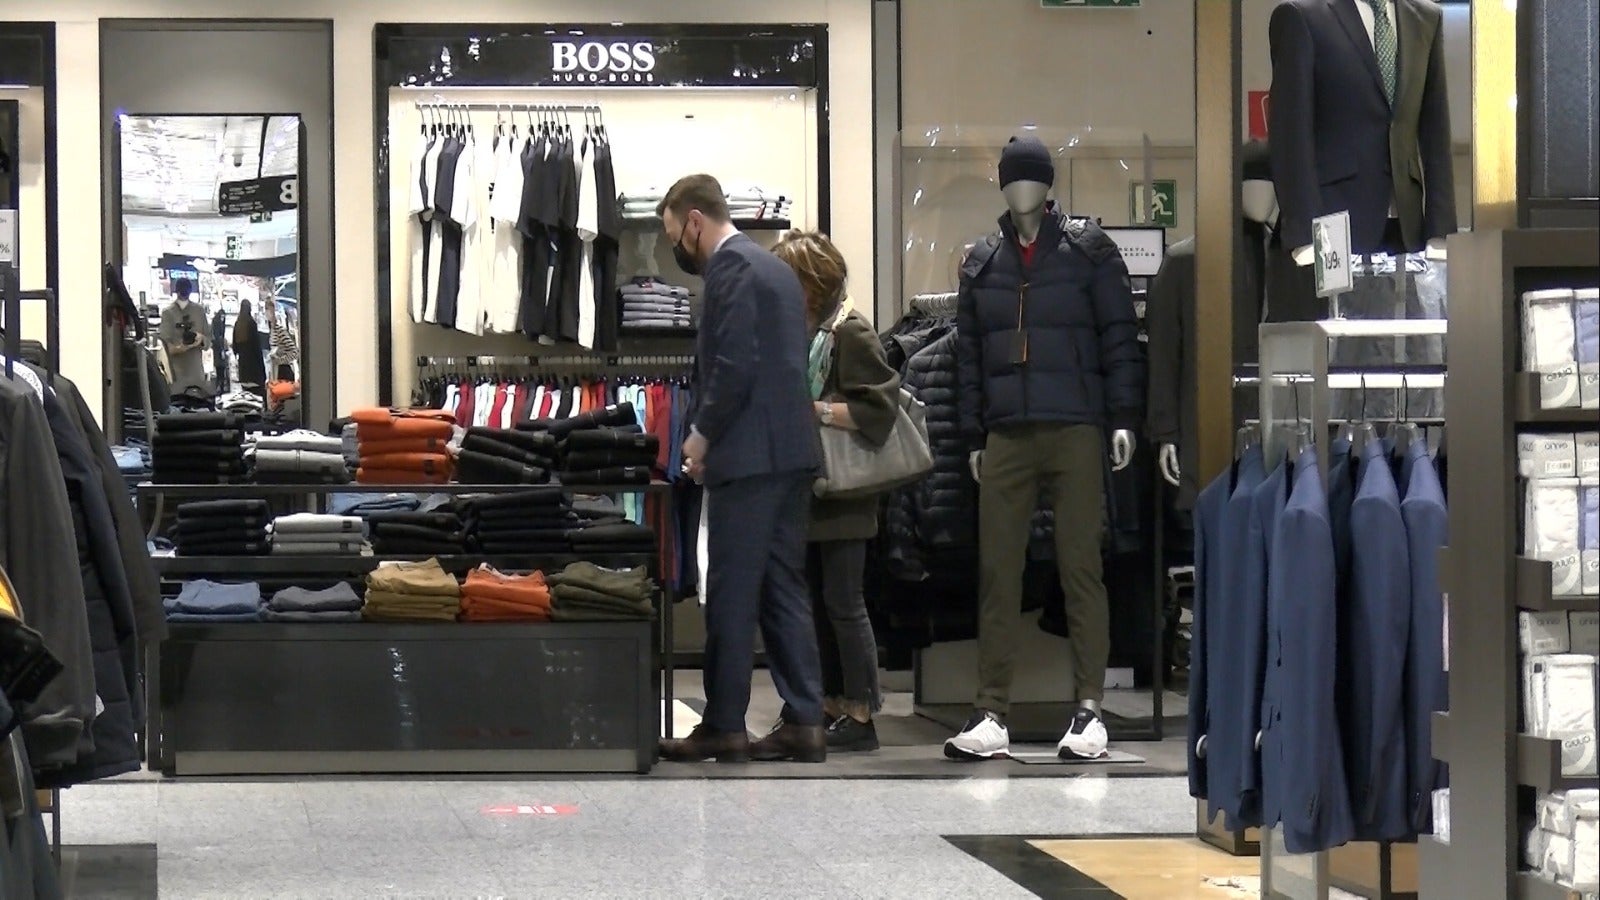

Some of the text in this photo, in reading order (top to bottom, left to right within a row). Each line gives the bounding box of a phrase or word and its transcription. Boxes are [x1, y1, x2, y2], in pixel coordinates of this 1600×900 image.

[552, 42, 655, 72] BOSS
[552, 72, 654, 82] HUGO BOSS
